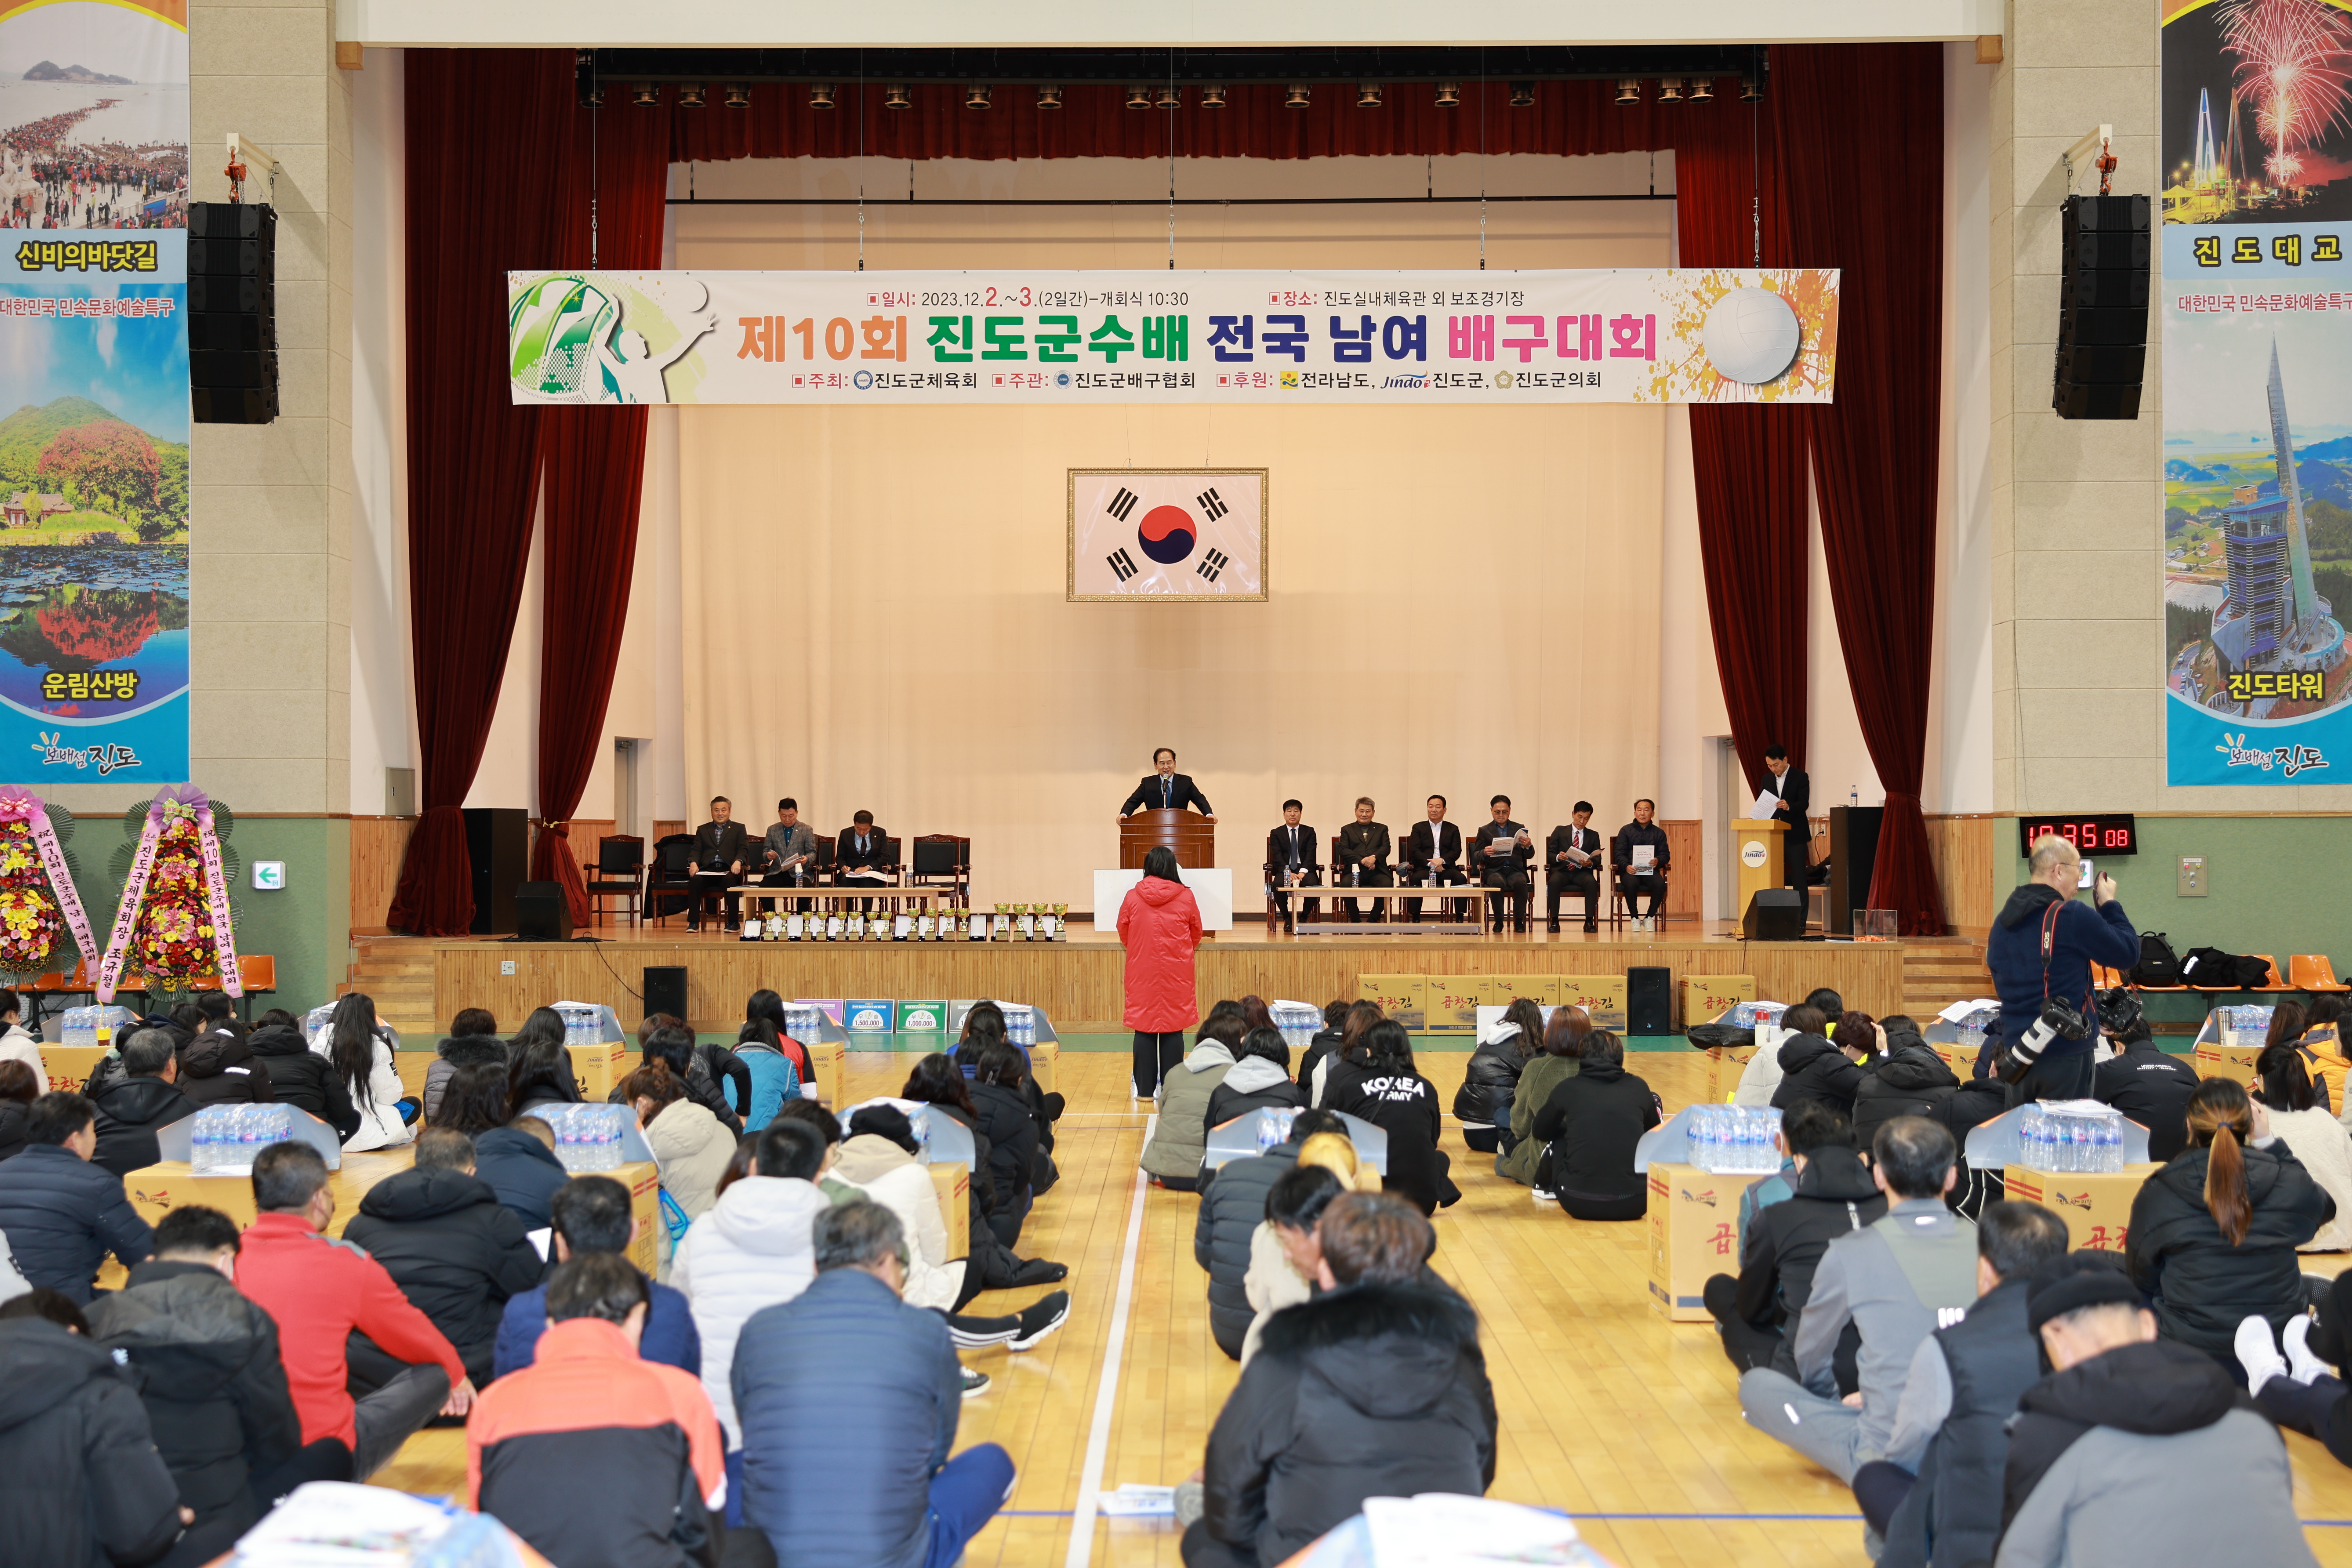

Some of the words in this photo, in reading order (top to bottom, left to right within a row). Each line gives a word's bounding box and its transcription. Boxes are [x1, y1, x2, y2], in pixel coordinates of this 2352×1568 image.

[16, 241, 157, 271] 신비의바닷길
[0, 299, 56, 316] 대한민국
[60, 298, 175, 317] 민속문화예술특구
[882, 292, 916, 307] 일시:
[1148, 292, 1189, 306] 10:30
[1283, 291, 1318, 307] 장소:
[1324, 291, 1426, 307] 진도실내체육관
[1432, 291, 1445, 307] 외
[1451, 291, 1524, 307] 보조경기장
[2178, 295, 2236, 312] 대한민국
[2240, 293, 2352, 312] 민속문화예술특구
[737, 315, 907, 362] 제10회
[926, 315, 1188, 363] 진도군수배
[1207, 315, 1309, 362] 전국
[1330, 315, 1426, 363] 남여
[1448, 314, 1656, 363] 배구대회
[809, 373, 849, 389] 주최:
[875, 372, 977, 389] 진도군체육회
[1009, 373, 1049, 388] 주관:
[1075, 372, 1195, 388] 진도군배구협회
[1233, 372, 1273, 388] 후원:
[1301, 372, 1375, 389] 전라남도,
[1380, 376, 1423, 389] Jindo
[1515, 372, 1601, 388] 진도군의회
[42, 671, 139, 700] 운림산방
[2227, 672, 2323, 700] 진도타워
[44, 748, 87, 768] 보배섬
[89, 744, 141, 775] 진도
[2228, 748, 2273, 769] 보배섬
[2275, 745, 2329, 777] 진도
[38, 829, 53, 839] 祝
[202, 829, 216, 838] 祝
[2105, 829, 2127, 847] 08
[42, 840, 62, 869] 제10회
[54, 872, 77, 907] 진도군수배
[115, 845, 152, 940] 진도군체육회장
[209, 871, 226, 909] 진도군수배
[216, 913, 229, 929] 전국
[78, 933, 96, 962] 배구대회
[219, 933, 231, 949] 남여
[102, 948, 122, 988] 조규철
[221, 953, 237, 985] 배구대회
[1376, 996, 1412, 1009] 곱창김
[1441, 996, 1480, 1009] 곱창김
[1361, 1076, 1425, 1097] KOREA
